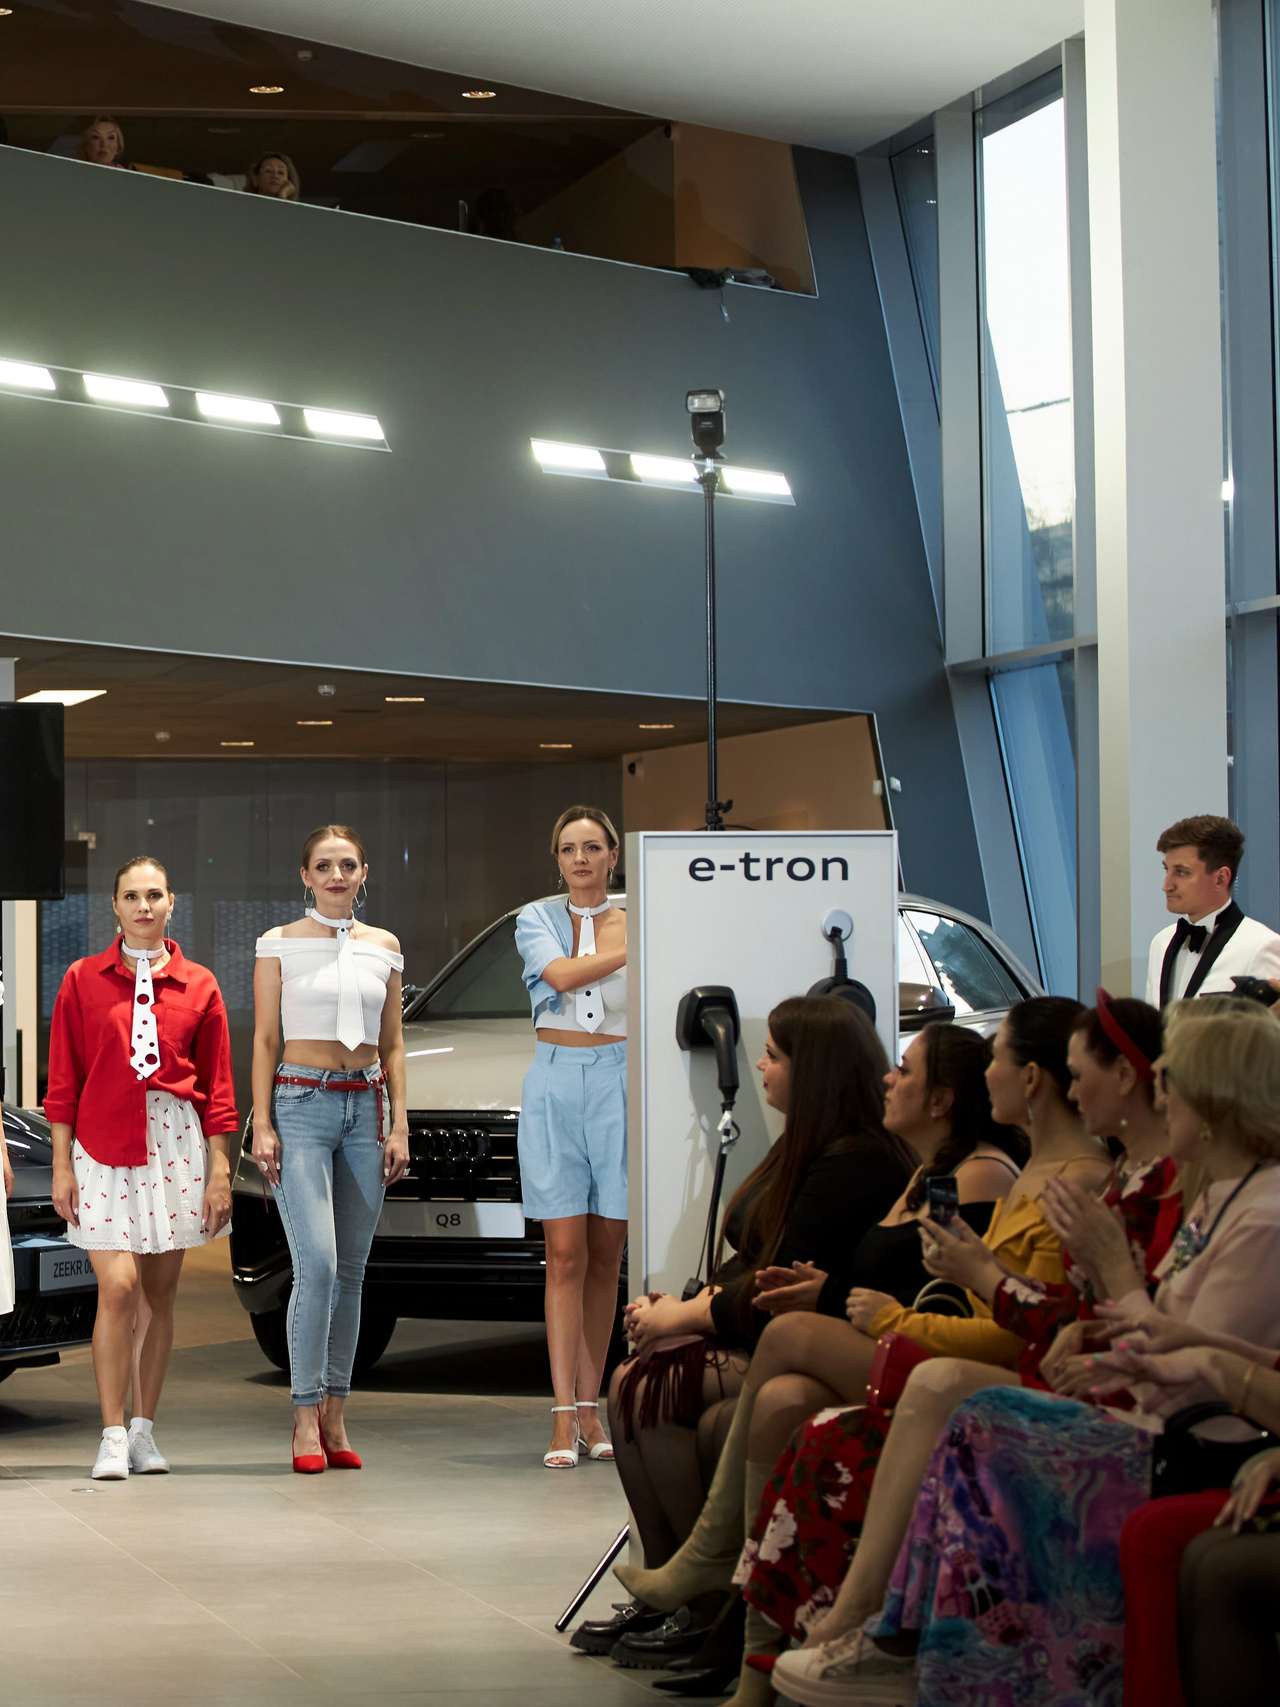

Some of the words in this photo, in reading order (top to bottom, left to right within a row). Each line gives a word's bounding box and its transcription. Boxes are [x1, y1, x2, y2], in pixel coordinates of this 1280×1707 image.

[688, 852, 849, 882] e-tron
[436, 1213, 462, 1229] Q8
[53, 1260, 82, 1278] ZEEKR
